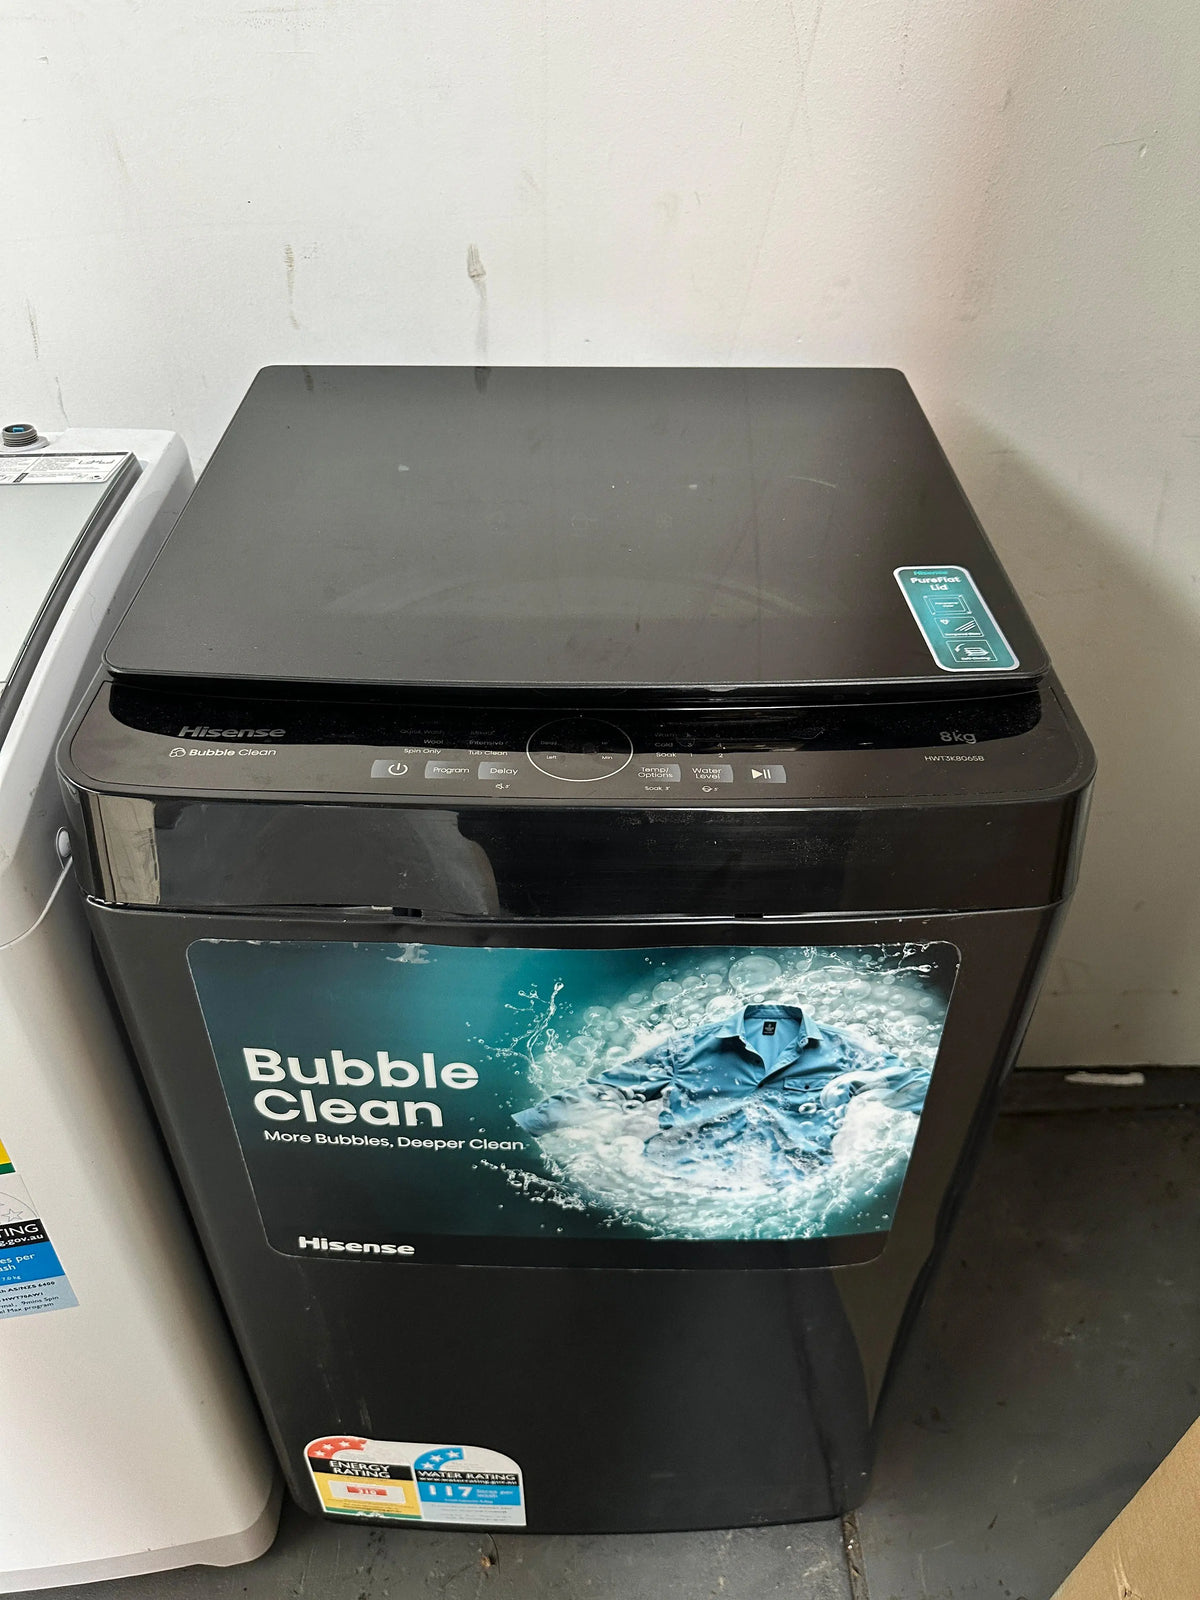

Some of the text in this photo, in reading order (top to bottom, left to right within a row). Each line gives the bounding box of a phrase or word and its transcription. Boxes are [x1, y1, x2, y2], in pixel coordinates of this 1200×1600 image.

[910, 576, 961, 584] PureFlat
[178, 726, 286, 737] Hisense
[939, 731, 977, 744] 8kg
[189, 748, 277, 756] Bubble Clean
[433, 766, 470, 774] Program
[490, 767, 519, 775] Delay
[243, 1047, 479, 1089] Bubble
[254, 1088, 443, 1127] Clean
[263, 1129, 524, 1151] More Bubbles, Deeper Clean
[298, 1236, 415, 1255] Hisense
[15, 1253, 35, 1264] per
[24, 1303, 55, 1311] program
[329, 1460, 390, 1472] ENERGY
[333, 1467, 391, 1478] RATING
[418, 1470, 516, 1481] WATER RATING
